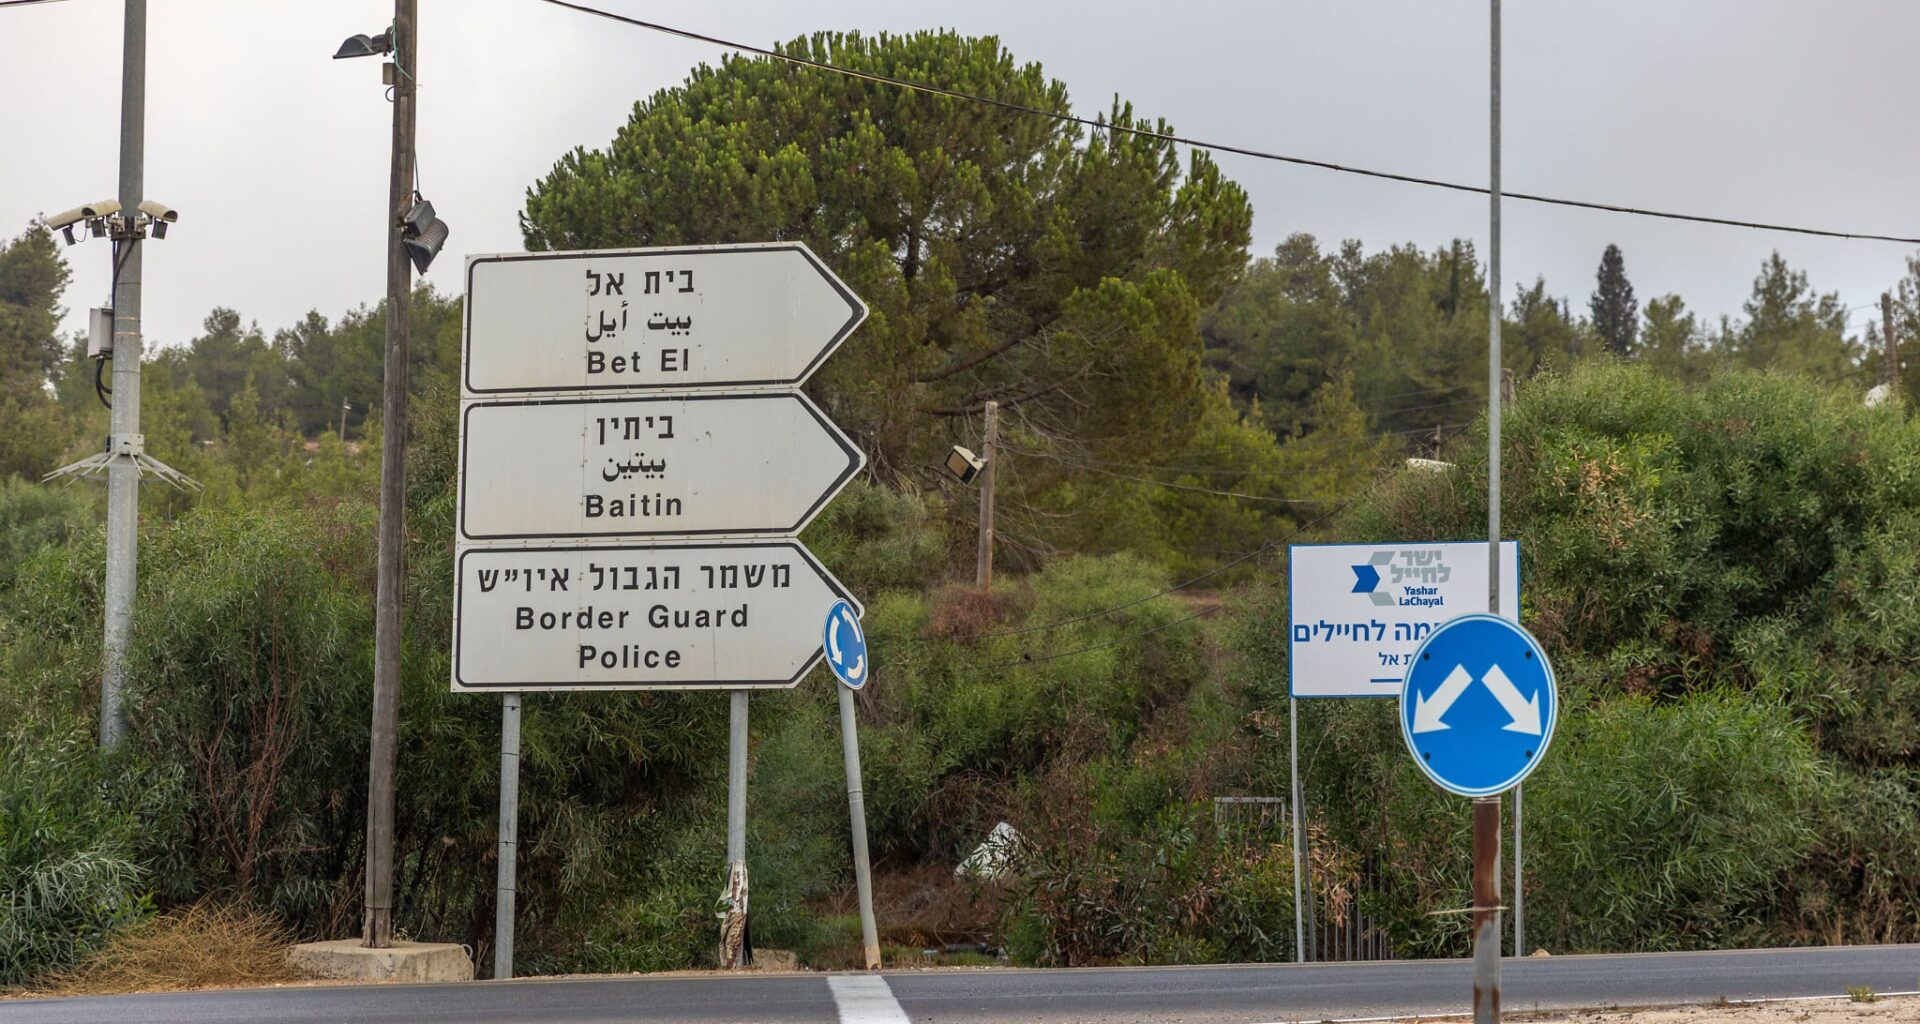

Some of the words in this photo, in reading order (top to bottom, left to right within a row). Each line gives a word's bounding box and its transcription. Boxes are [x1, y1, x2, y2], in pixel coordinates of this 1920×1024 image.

[586, 269, 624, 296] אל
[644, 270, 694, 294] בית
[585, 300, 629, 343] أيل
[647, 312, 692, 336] بيت
[587, 351, 641, 374] Bet
[660, 348, 689, 372] El
[596, 415, 674, 445] ביתין
[602, 452, 666, 482] بيتين
[585, 493, 682, 518] Baitin
[1399, 550, 1442, 567] ישר
[589, 563, 681, 592] הגבול
[700, 563, 791, 589] משמר
[1390, 562, 1452, 584] לחייל
[1398, 595, 1445, 608] LaChayal
[1404, 585, 1439, 596] Yashar
[515, 605, 630, 630] Border
[648, 603, 749, 629] Guard
[1294, 619, 1387, 642] לחיילים
[1395, 622, 1443, 641] מה
[578, 644, 682, 669] Police
[1378, 651, 1400, 666] אל
